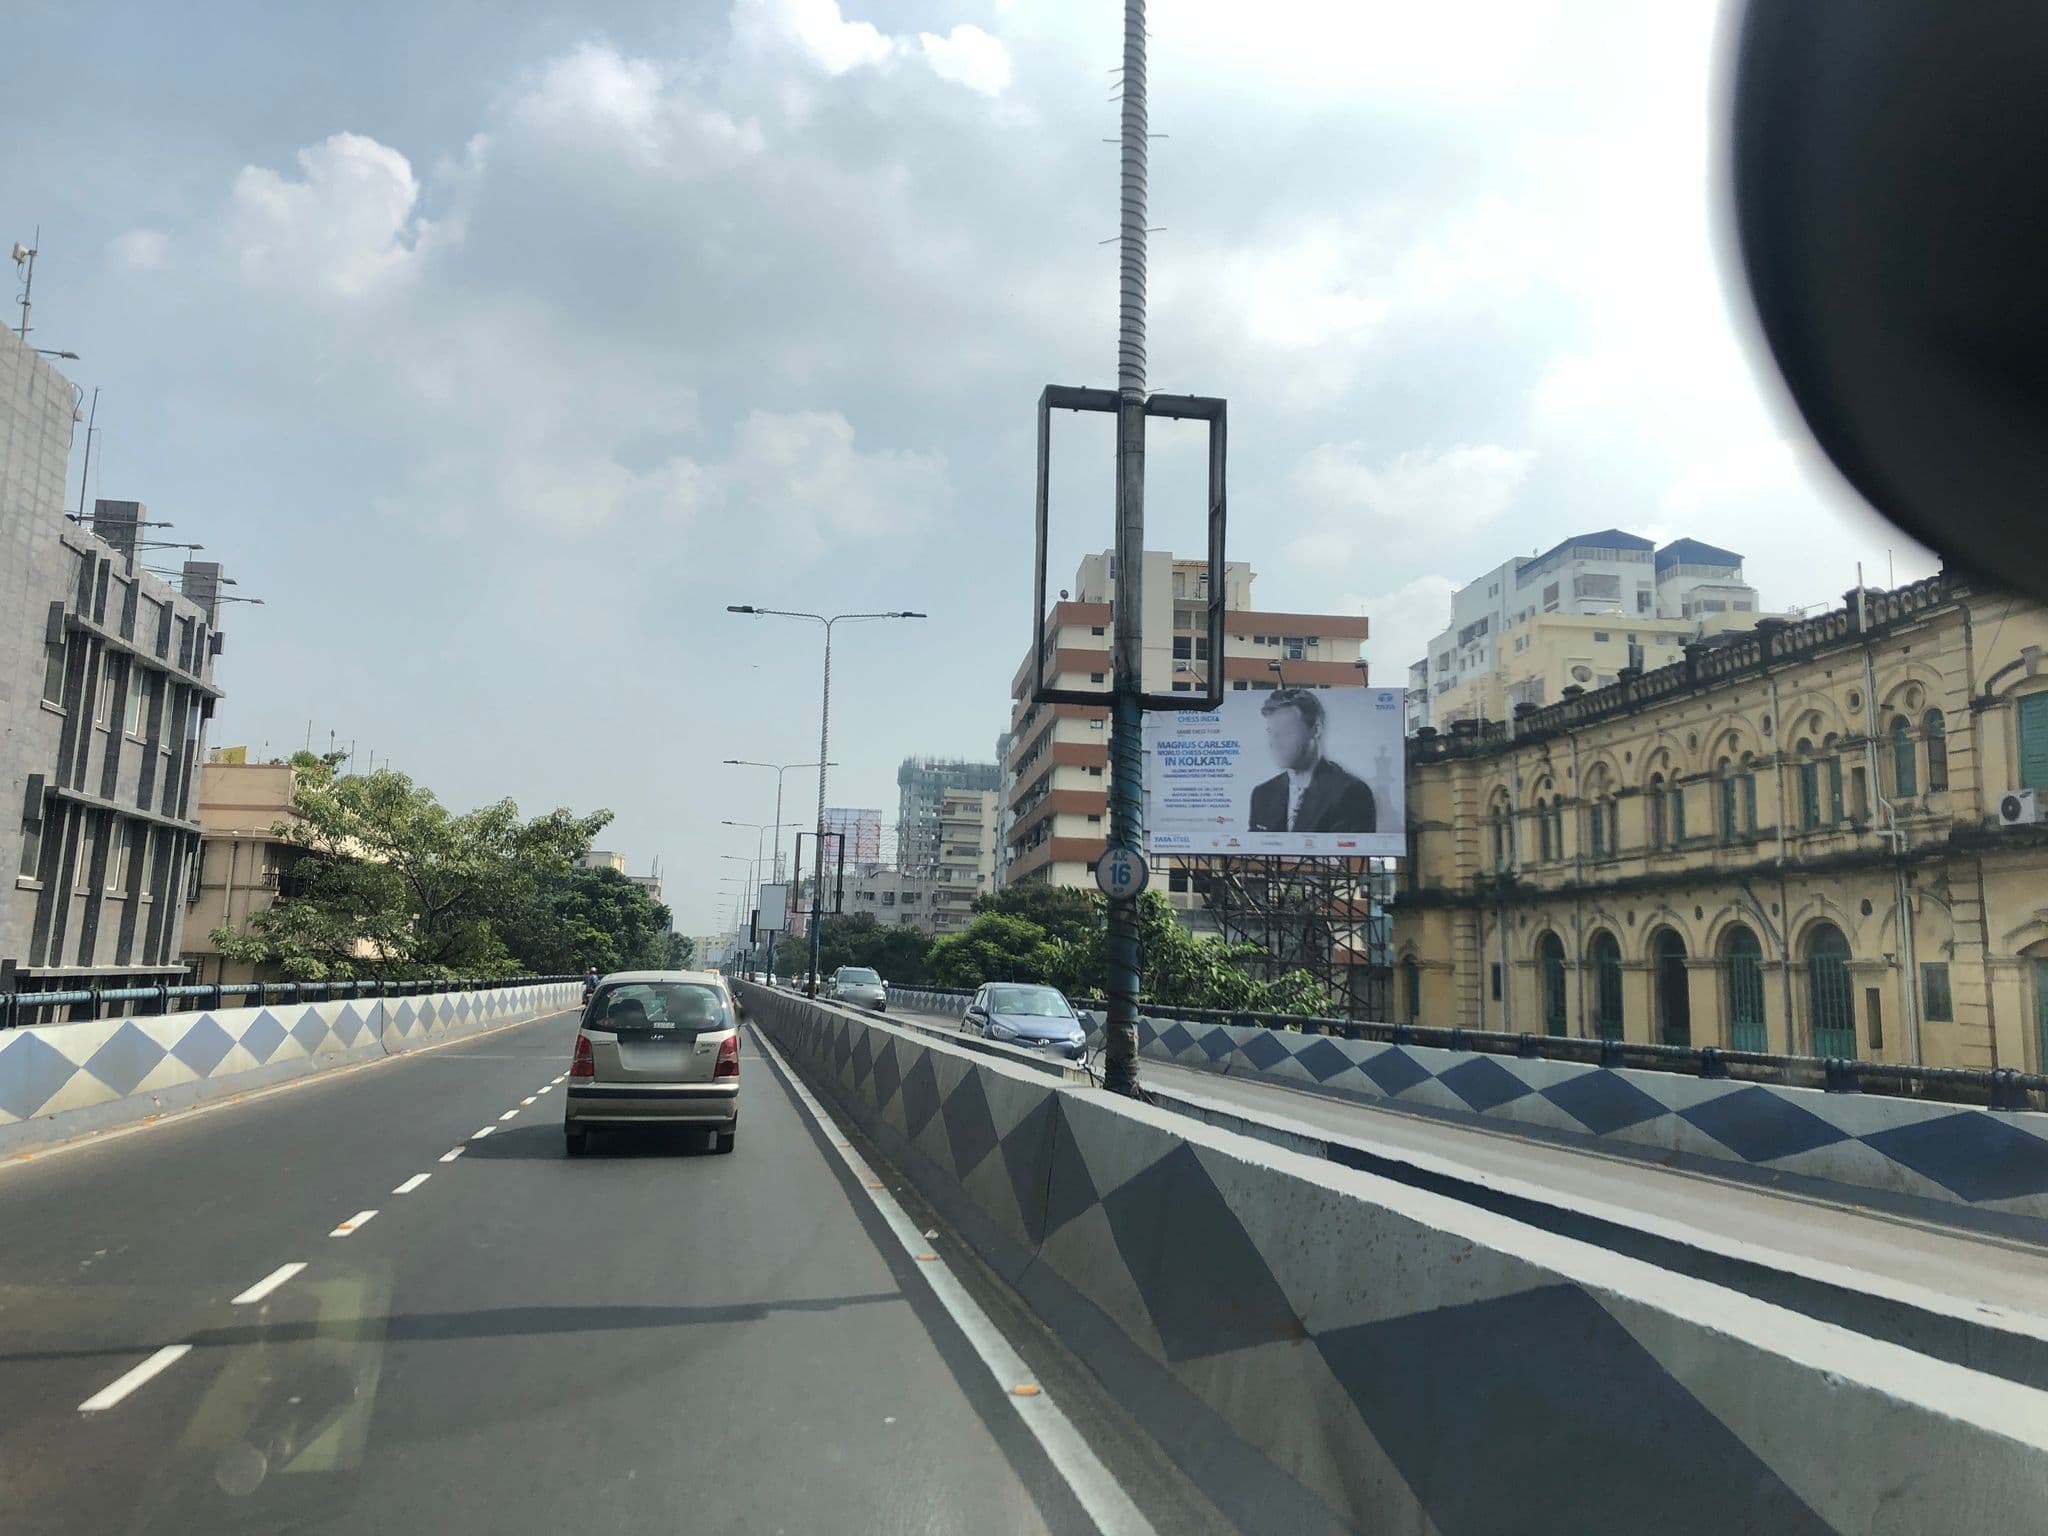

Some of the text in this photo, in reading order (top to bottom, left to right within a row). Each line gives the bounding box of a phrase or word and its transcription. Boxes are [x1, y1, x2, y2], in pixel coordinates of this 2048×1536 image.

[1157, 740, 1241, 749] MAGNUS CARLSEN.
[1164, 756, 1232, 766] IN KOLKATA.
[1109, 863, 1131, 885] 16
